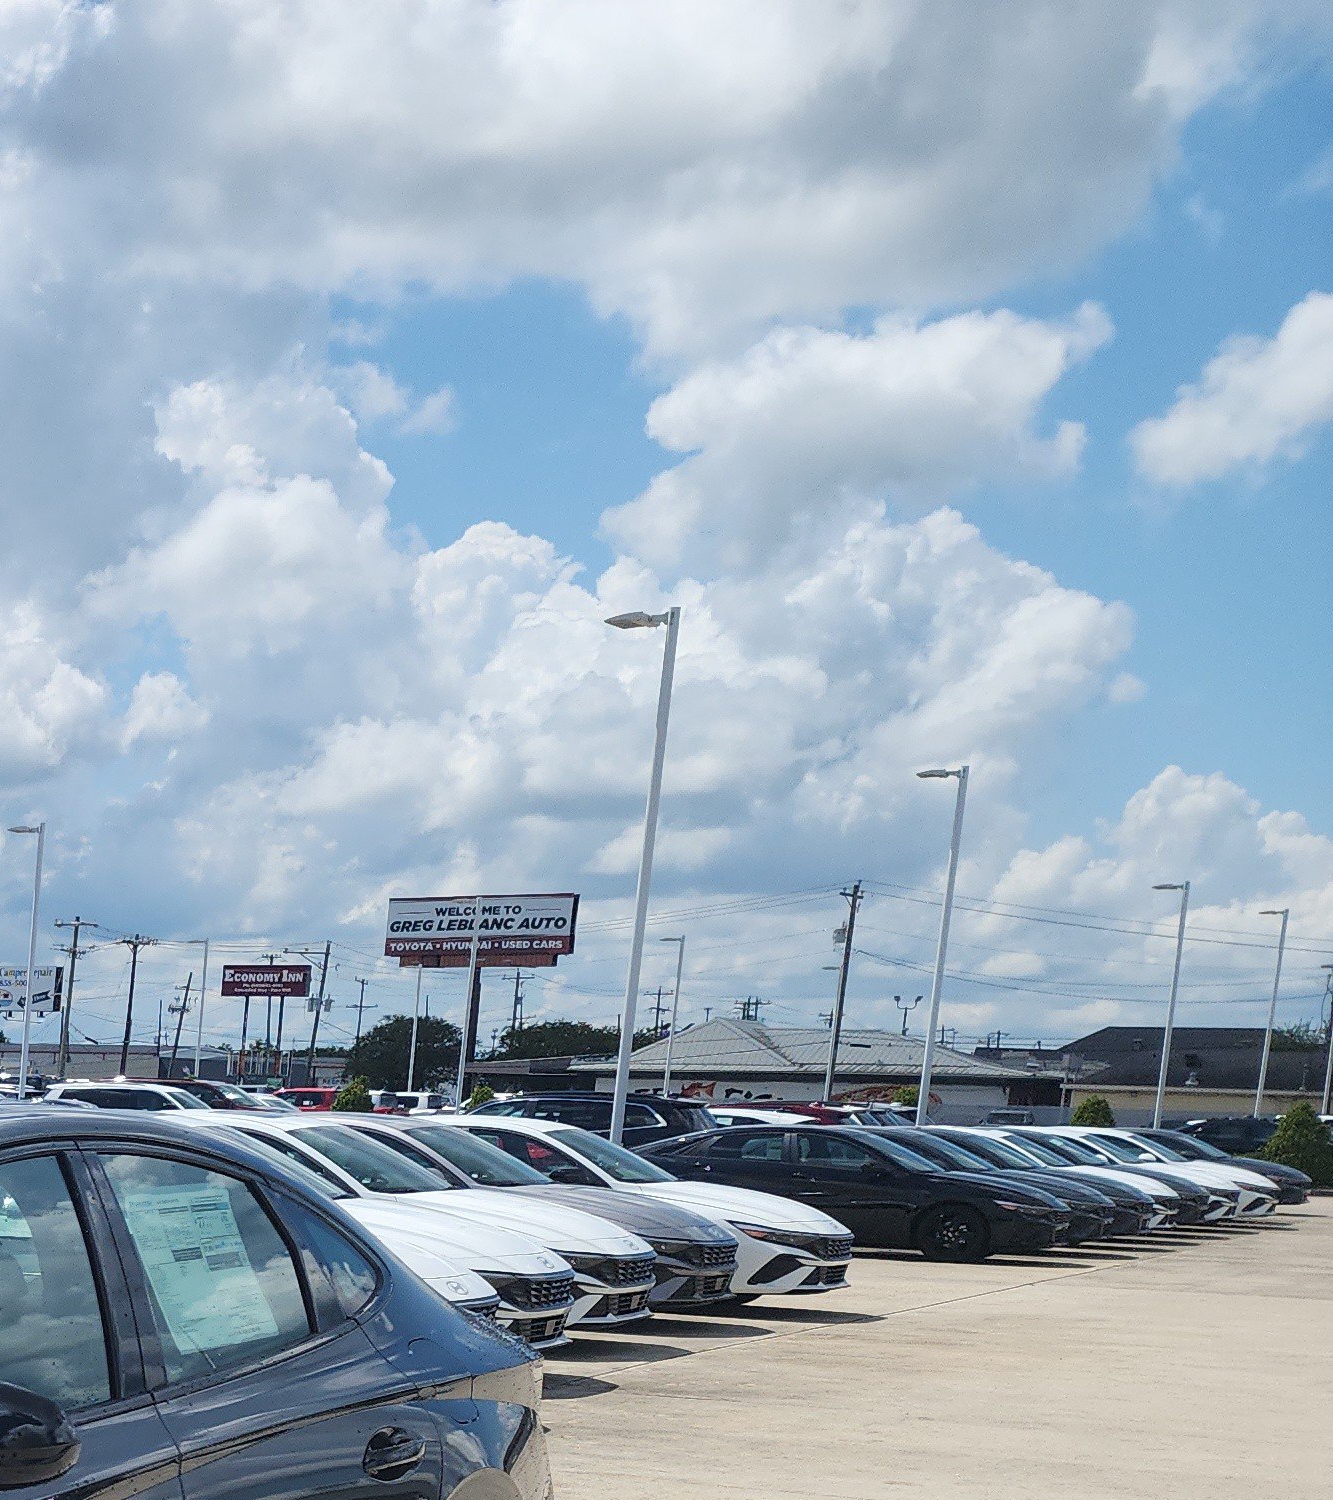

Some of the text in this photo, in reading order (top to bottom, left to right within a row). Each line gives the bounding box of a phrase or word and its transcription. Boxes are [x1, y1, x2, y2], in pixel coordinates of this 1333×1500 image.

[504, 905, 522, 915] TO
[389, 920, 434, 933] GREG
[517, 916, 568, 930] AUTO
[389, 941, 433, 951] TOYOTA
[501, 940, 531, 949] USED
[533, 940, 563, 949] CARS
